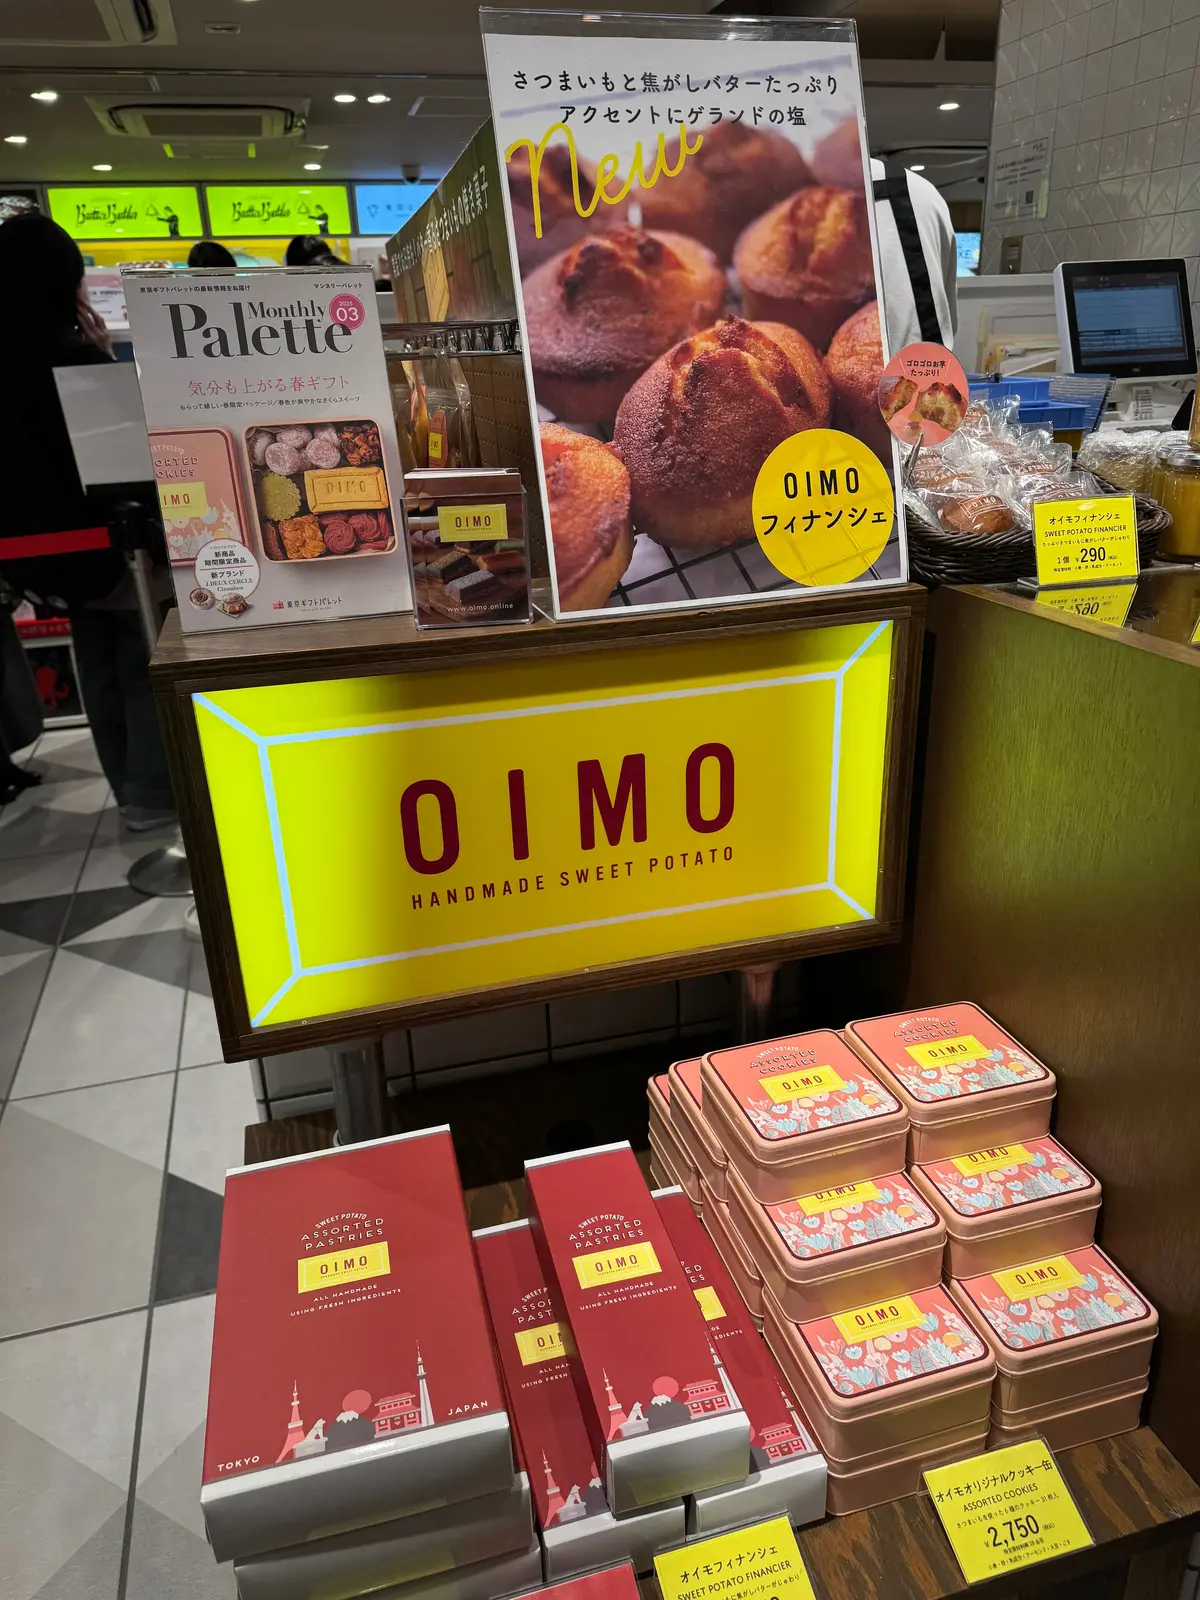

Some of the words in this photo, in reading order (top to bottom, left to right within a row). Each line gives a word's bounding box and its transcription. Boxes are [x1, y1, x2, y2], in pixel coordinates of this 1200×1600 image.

[512, 70, 838, 95] さつまいもと焦がしバターたっぷり
[560, 104, 807, 126] アクセントにゲランドの塩
[248, 300, 326, 322] Monthly
[336, 307, 359, 322] 03
[161, 301, 353, 359] Palette
[906, 359, 946, 369] ゴロゴロお芋
[187, 374, 350, 397] 気分も上がる春ギフト
[783, 467, 860, 499] OIMO
[972, 496, 996, 508] OIMO
[455, 515, 491, 528] OIMO
[761, 507, 888, 536] フィナンシェ
[1049, 512, 1121, 526] オイモフィナンシェ
[1044, 529, 1065, 538] SWEET
[1066, 527, 1093, 536] POTATO
[1094, 524, 1127, 533] FINANCIER
[204, 557, 247, 566] 期間限定商品
[214, 550, 236, 558] 新商品
[1075, 546, 1106, 564] ¥290
[210, 570, 245, 579] 新ブランド
[286, 596, 342, 609] 東京ギフトパレット
[446, 602, 514, 613] www.oimo.online
[399, 741, 736, 876] OIMO
[411, 875, 545, 911] HANDMADE
[560, 861, 634, 887] SWEET
[649, 846, 734, 873] POTATO
[928, 1044, 968, 1058] OIMO
[782, 1075, 823, 1091] OIMO
[300, 1217, 384, 1242] ASSORTED
[315, 1214, 340, 1229] SWEET
[341, 1212, 368, 1220] POTATO
[568, 1219, 642, 1241] ASSORTED
[578, 1215, 599, 1229] SWEET
[600, 1213, 625, 1221] POTATO
[305, 1228, 383, 1251] PASTRIES
[575, 1228, 644, 1250] PASTRIES
[320, 1255, 368, 1275] OIMO
[594, 1254, 638, 1273] OIMO
[1015, 1266, 1059, 1285] OIMO
[332, 1284, 378, 1299] HANDMADE
[521, 1288, 542, 1303] SWEET
[613, 1280, 654, 1294] HANDMADE
[290, 1307, 315, 1317] USING
[318, 1300, 344, 1310] FRESH
[347, 1288, 402, 1304] INGREDIENTS
[580, 1301, 602, 1311] USING
[604, 1296, 627, 1305] FRESH
[629, 1285, 677, 1300] INGREDIENTS
[854, 1305, 899, 1326] OIMO
[521, 1379, 543, 1389] USING
[545, 1373, 568, 1382] FRESH
[447, 1400, 489, 1416] JAPAN
[217, 1455, 260, 1472] TOKYO
[935, 1459, 1053, 1503] オイモオリジナルクッキー缶
[963, 1493, 1003, 1513] ASSORTED
[1003, 1482, 1039, 1500] COOKIES
[984, 1514, 1040, 1549] ¥2,750
[680, 1546, 778, 1584] オイモフィナンシェ
[677, 1587, 706, 1600] SWEET
[708, 1575, 744, 1593] POTATO
[745, 1560, 792, 1582] FINANCIER
